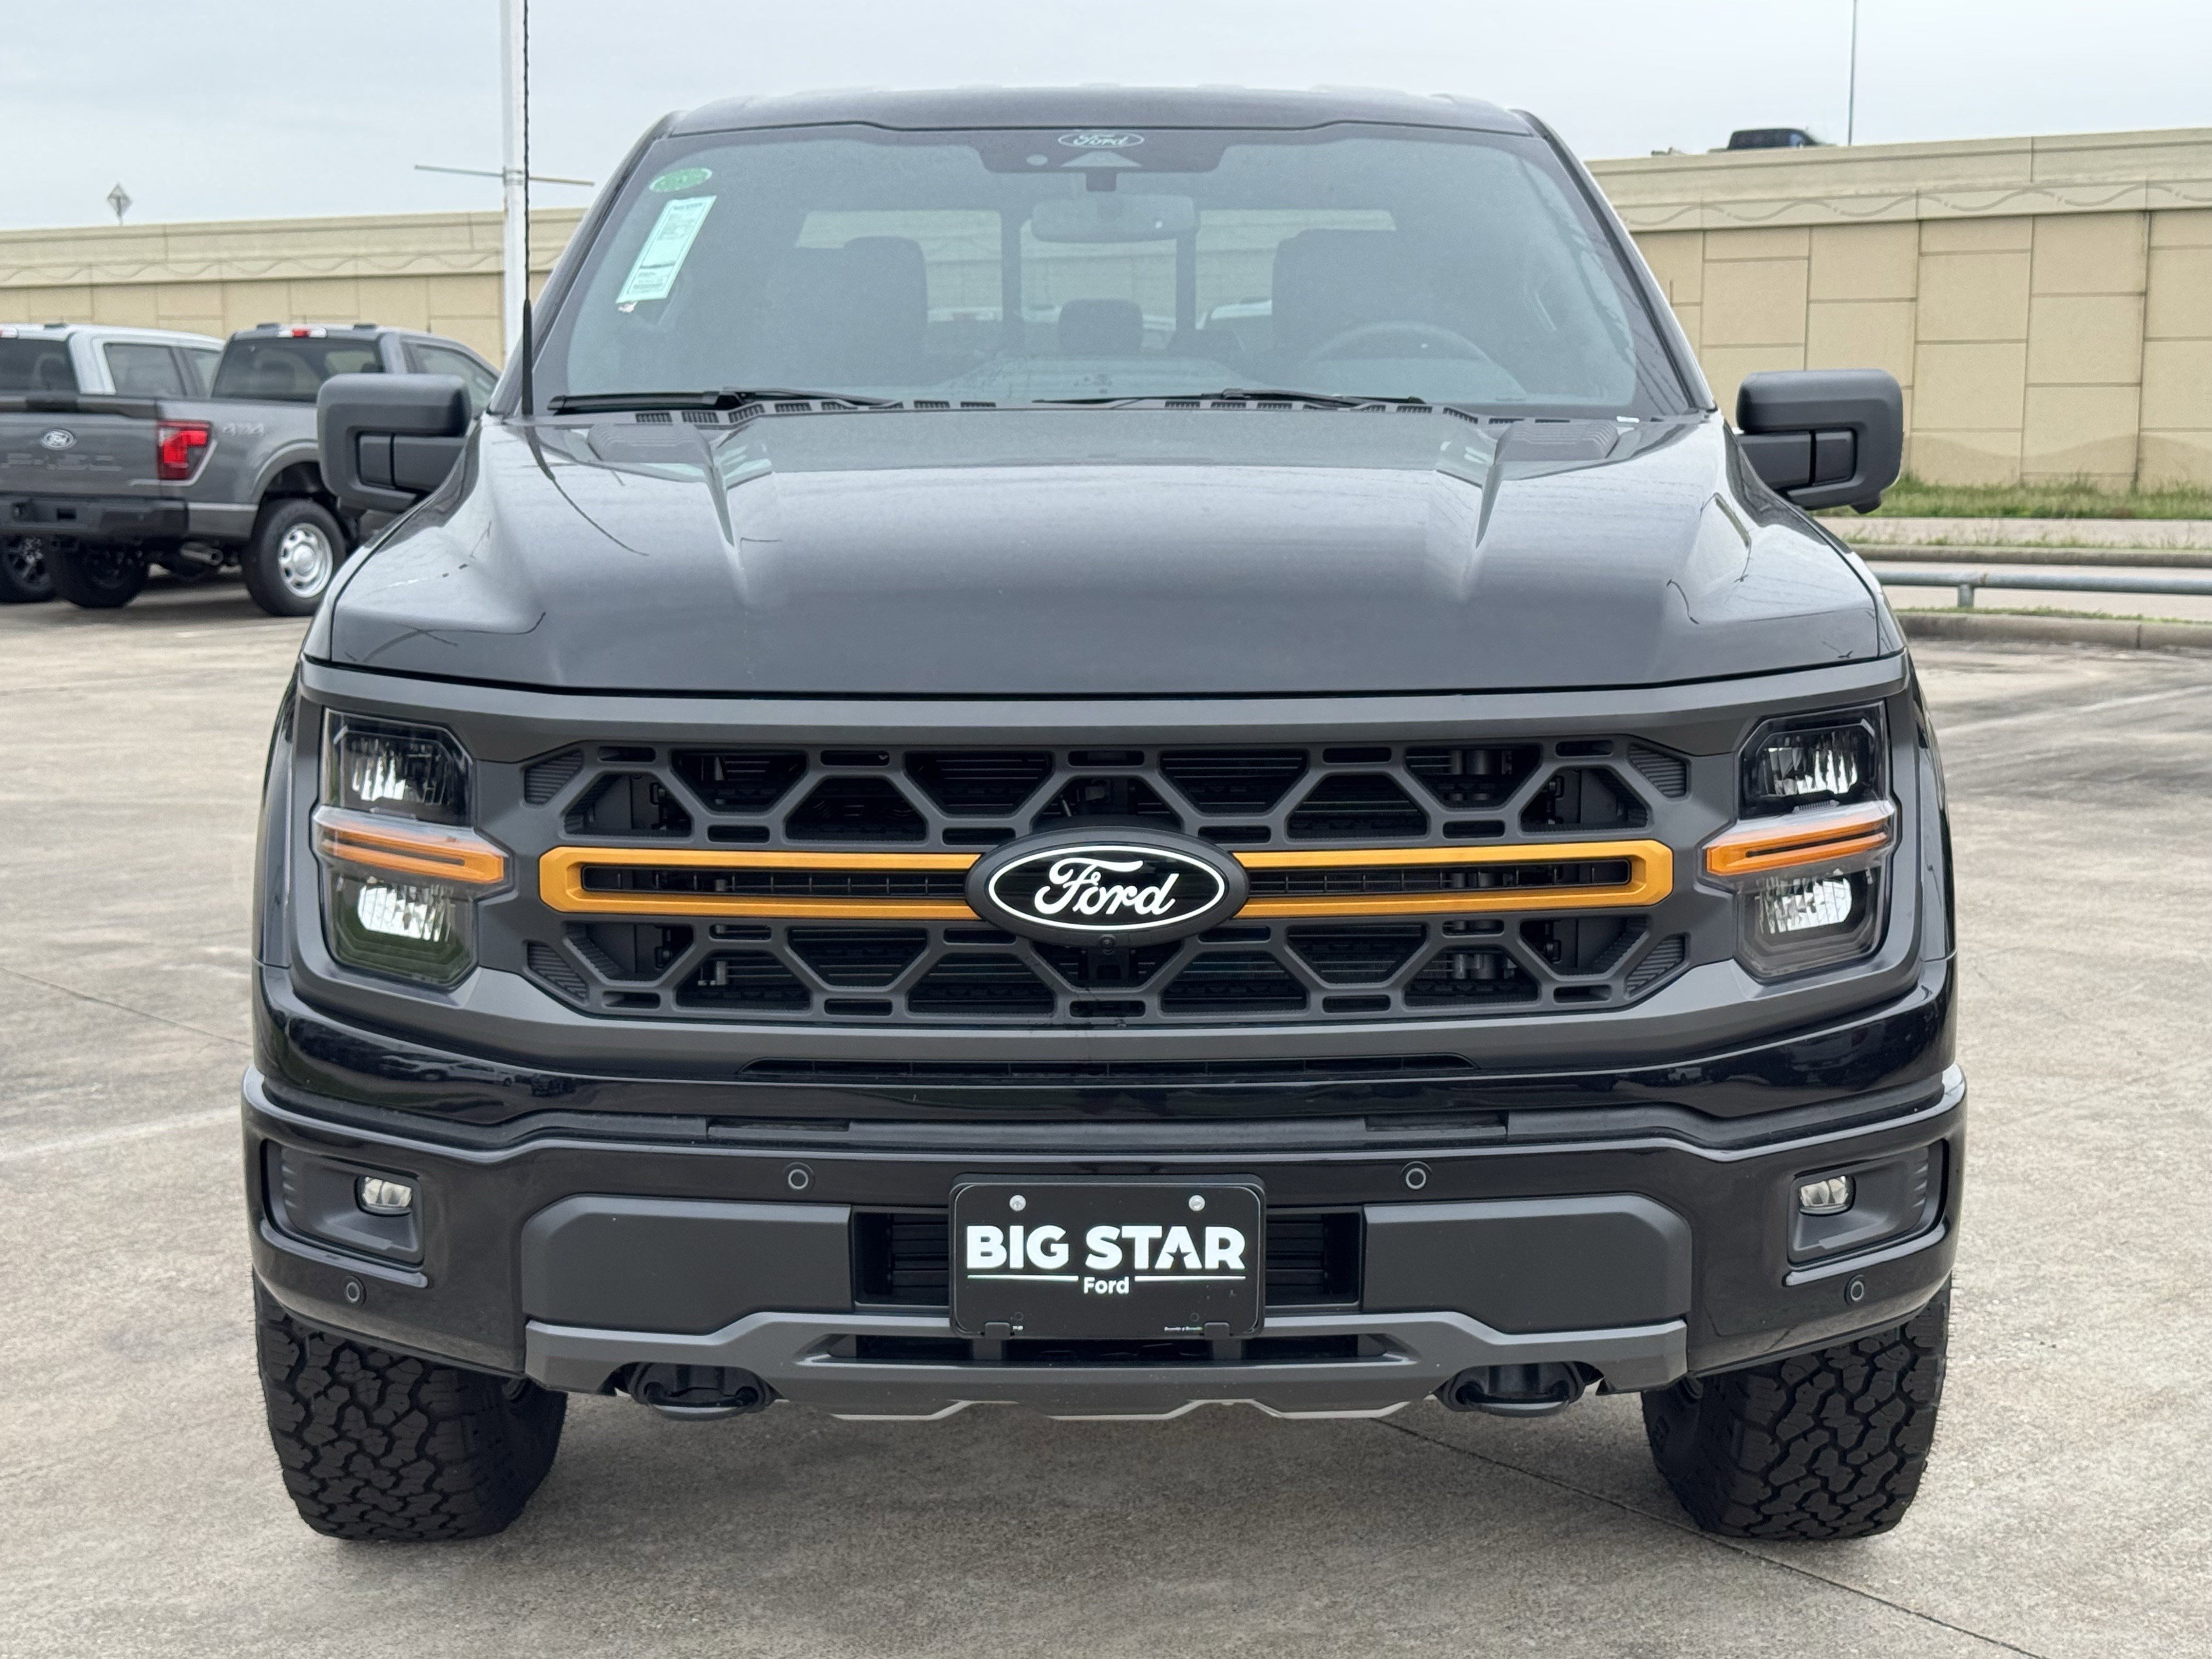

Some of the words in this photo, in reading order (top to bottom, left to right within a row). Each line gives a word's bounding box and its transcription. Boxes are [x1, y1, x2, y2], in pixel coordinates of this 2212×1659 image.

[1073, 134, 1128, 146] Ford
[1034, 857, 1180, 915] Ford
[967, 1225, 1069, 1269] BIG
[1085, 1225, 1245, 1270] STAR
[1084, 1276, 1130, 1295] Ford
